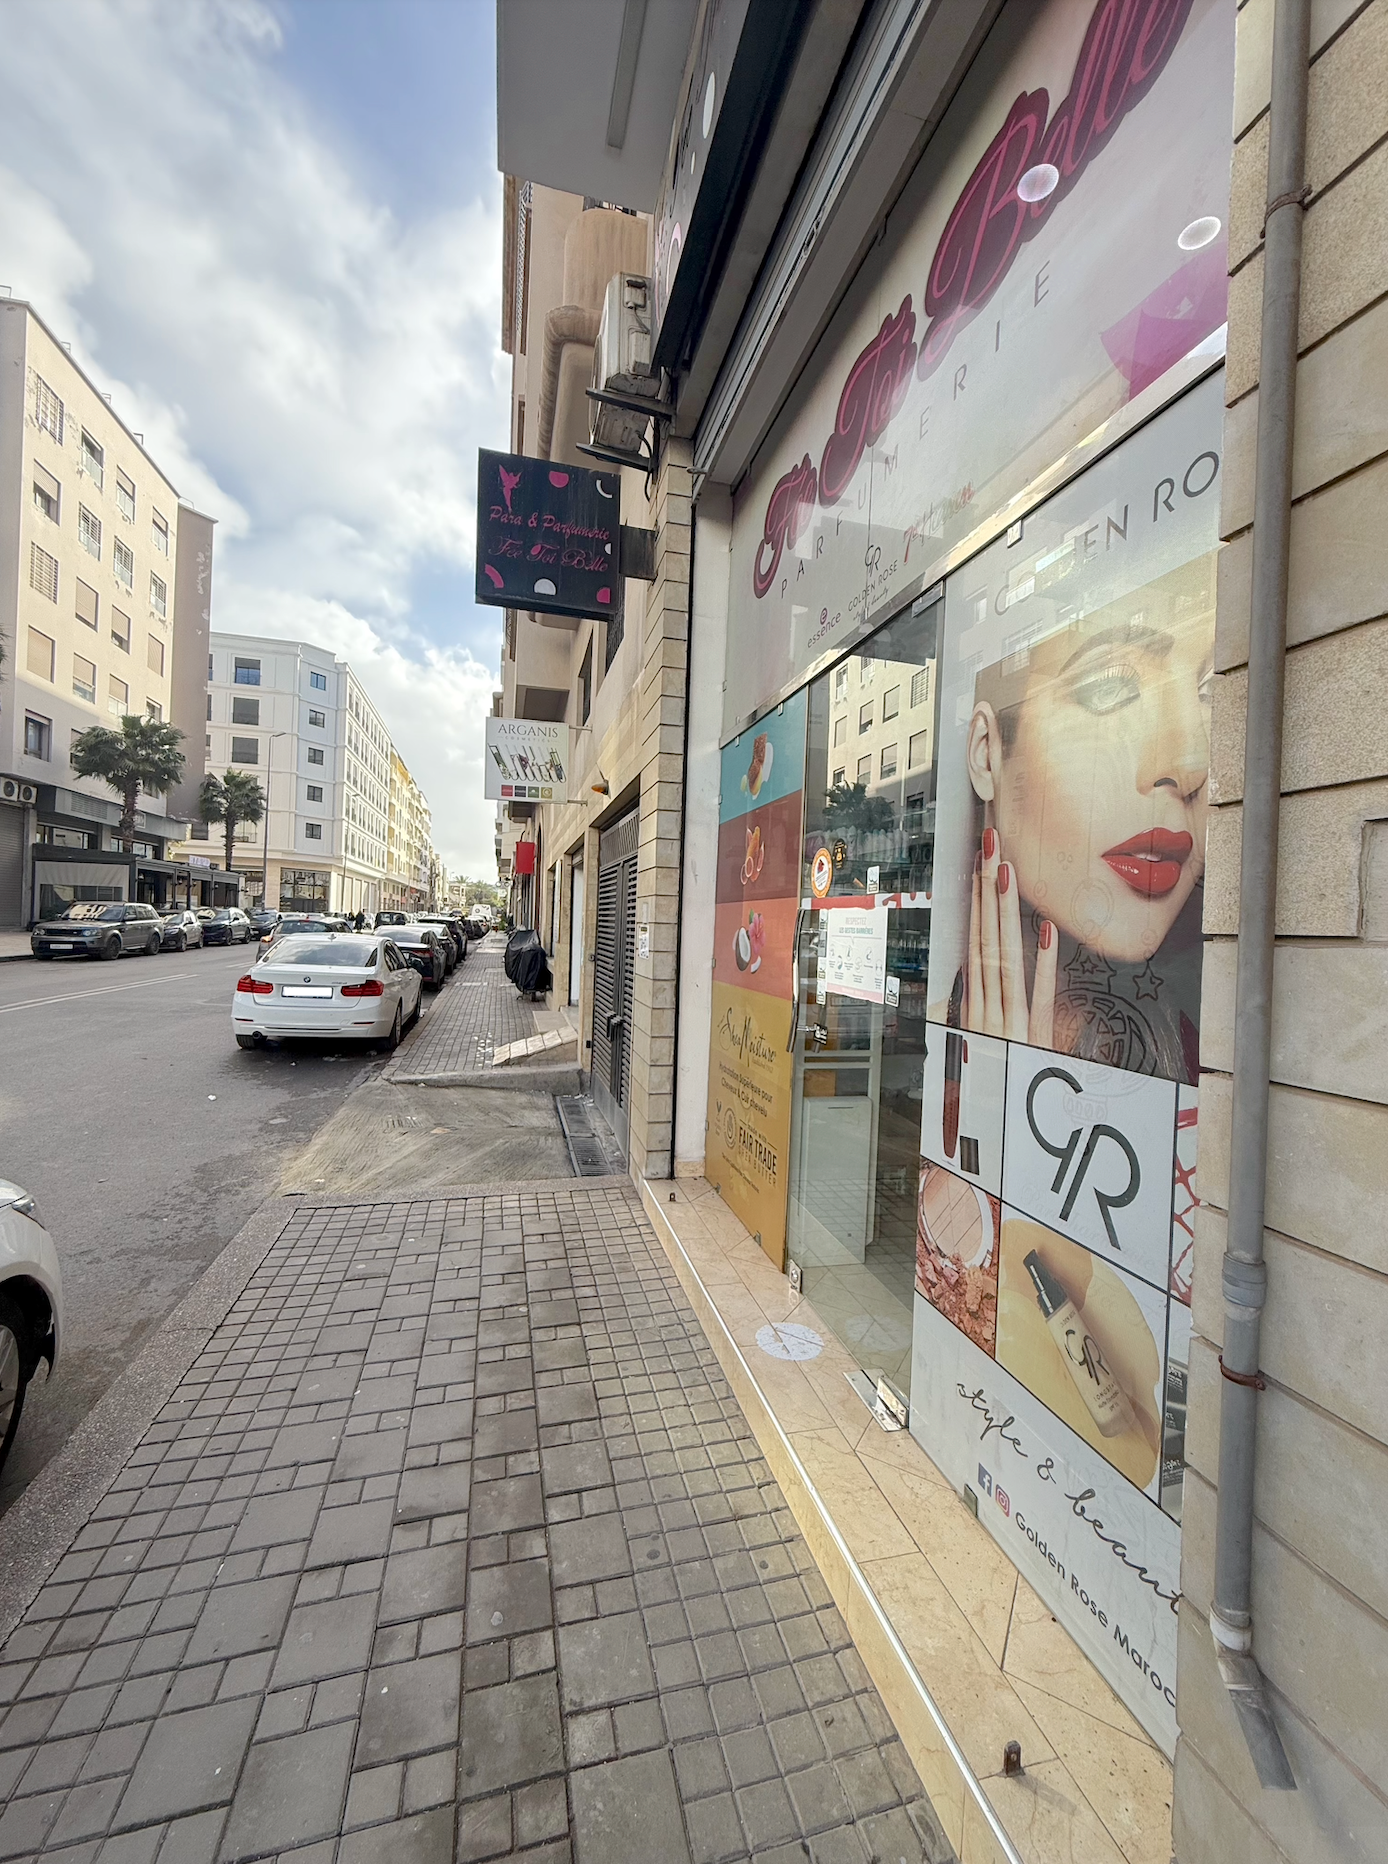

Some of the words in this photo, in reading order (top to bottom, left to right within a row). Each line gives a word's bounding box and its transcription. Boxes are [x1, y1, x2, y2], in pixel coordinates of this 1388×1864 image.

[819, 294, 917, 508] Toi
[917, 0, 1192, 382] Belle
[780, 260, 1050, 600] PARFUMERIE
[489, 505, 522, 526] Para
[528, 511, 539, 528] &
[542, 514, 610, 540] Parfumerie
[526, 543, 560, 564] Toi
[848, 580, 876, 612] GOLDEN
[878, 559, 898, 585] ROSE
[808, 612, 841, 648] essence
[498, 723, 558, 738] ARGANIS
[739, 1126, 753, 1154] FAIR
[754, 1139, 777, 1176] TRADE
[753, 1159, 777, 1188] BUTTER
[956, 1383, 1028, 1458] style
[1037, 1457, 1056, 1485] &
[1015, 1511, 1066, 1580] Golden
[1070, 1572, 1109, 1629] Rose
[1113, 1623, 1177, 1708] Maroc
